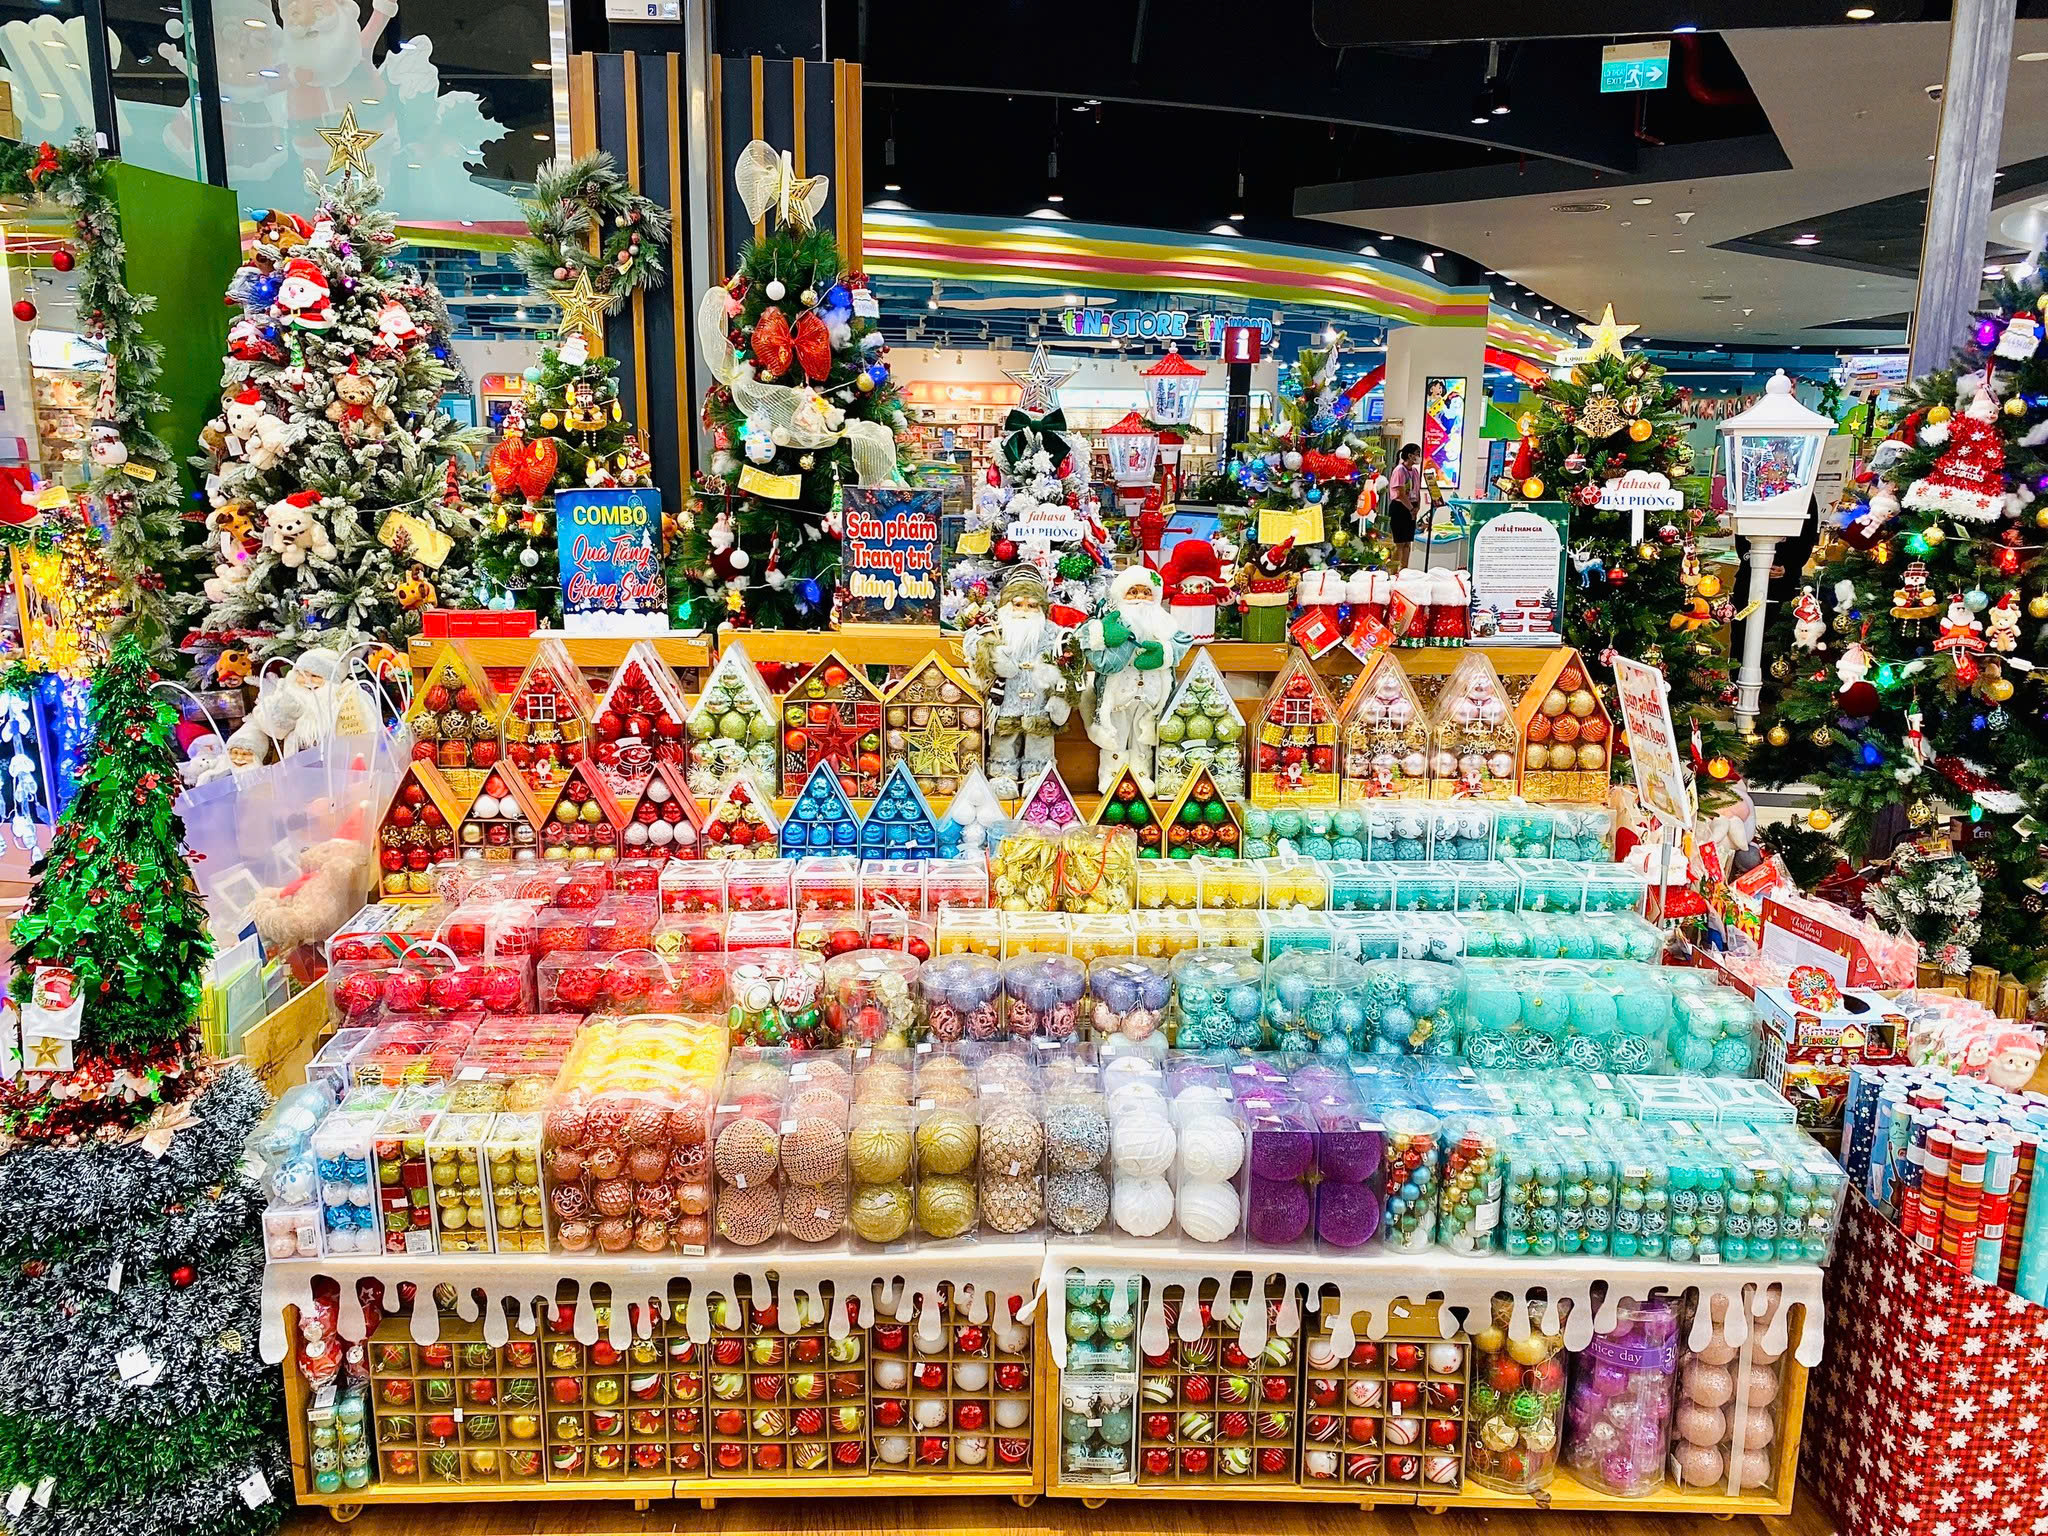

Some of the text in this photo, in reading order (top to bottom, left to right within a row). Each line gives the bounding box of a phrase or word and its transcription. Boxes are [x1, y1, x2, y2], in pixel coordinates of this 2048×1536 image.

[1606, 77, 1624, 85] EXIT
[1614, 478, 1661, 491] fahasa
[1629, 494, 1675, 506] PHÒNG
[573, 505, 648, 526] COMBO
[1026, 511, 1066, 523] fahasa
[847, 512, 937, 547] Sản phẩm
[1039, 525, 1078, 537] PHÒNG
[1494, 524, 1506, 532] THỂ
[1507, 525, 1514, 533] LỆ
[572, 534, 611, 571] Quà
[850, 541, 933, 576] Trang trí
[568, 571, 660, 609] Giáng Sinh
[850, 571, 936, 610] Giáng Sinh
[1973, 831, 1992, 839] LED
[1791, 916, 1823, 939] Christmas
[1591, 1341, 1615, 1357] nice
[1619, 1349, 1642, 1365] day
